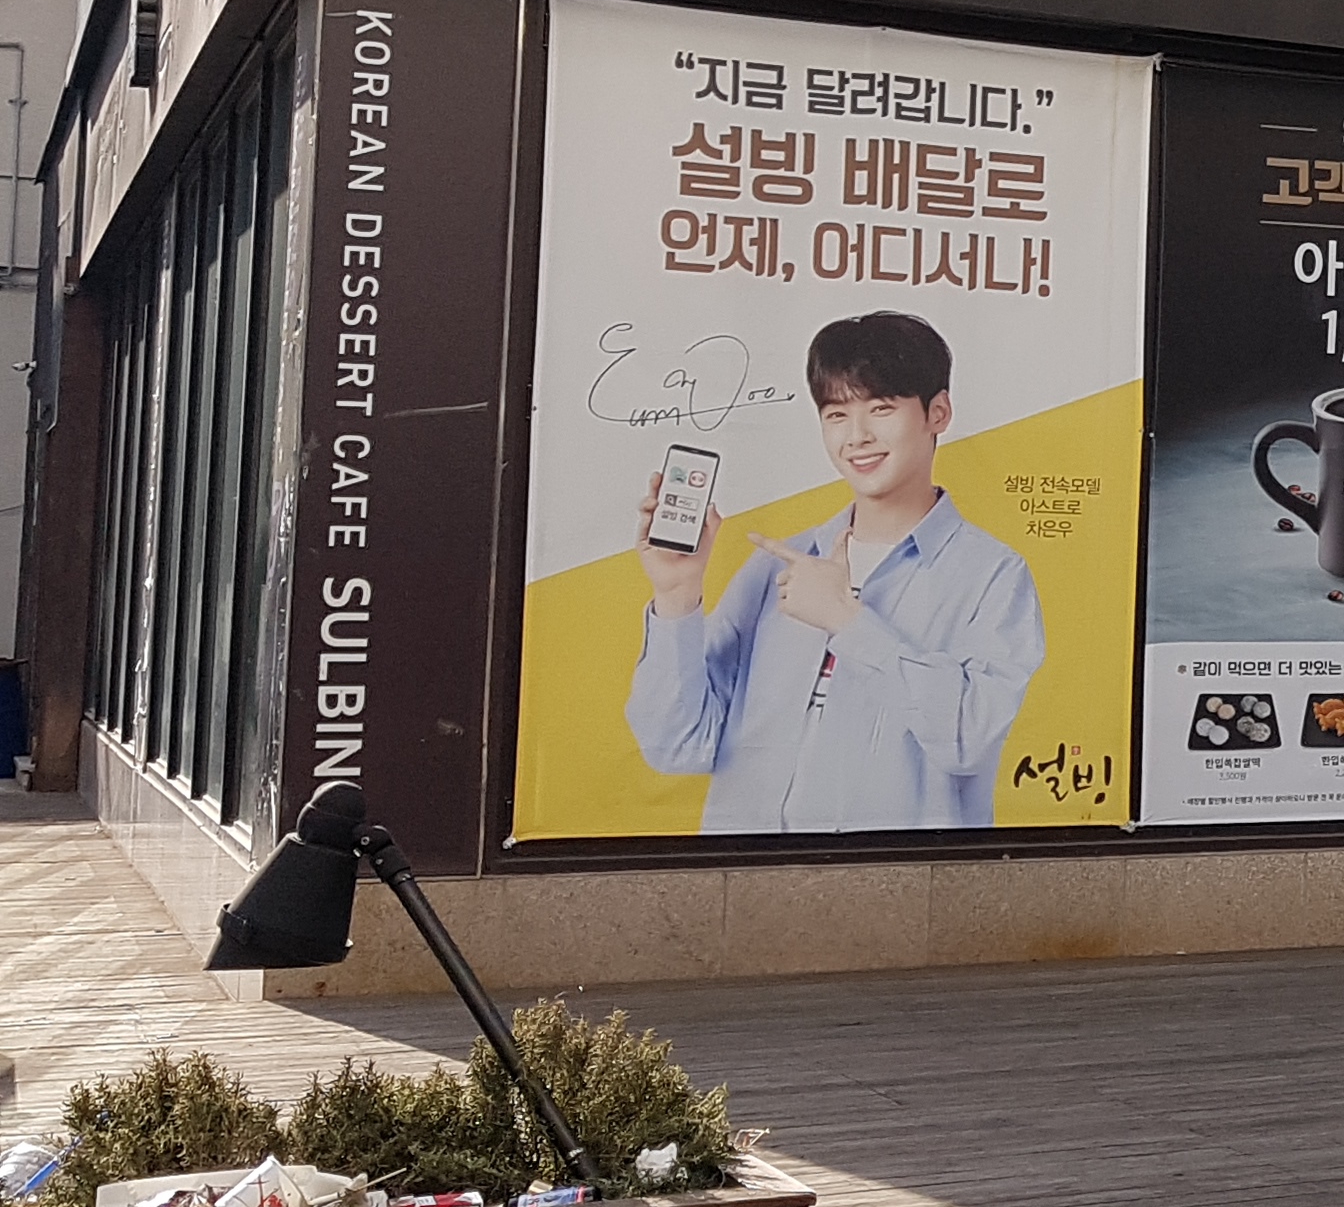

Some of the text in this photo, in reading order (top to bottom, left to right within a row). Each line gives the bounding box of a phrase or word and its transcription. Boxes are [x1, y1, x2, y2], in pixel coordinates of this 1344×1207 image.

[672, 122, 1048, 222] 설빙 배달로
[660, 209, 1052, 298] 언제, 어디서나!
[313, 8, 393, 780] KOREAN DESSERT CAFE SULBIN
[1004, 475, 1101, 495] 설빙 전속모델
[1020, 498, 1082, 515] 아스트로
[1026, 520, 1073, 538] 차은우
[1193, 661, 1221, 677] 같이
[1228, 661, 1271, 676] 먹으면
[1279, 661, 1292, 676] 더
[1299, 661, 1342, 676] 맛있는
[1014, 743, 1112, 804] 설빙
